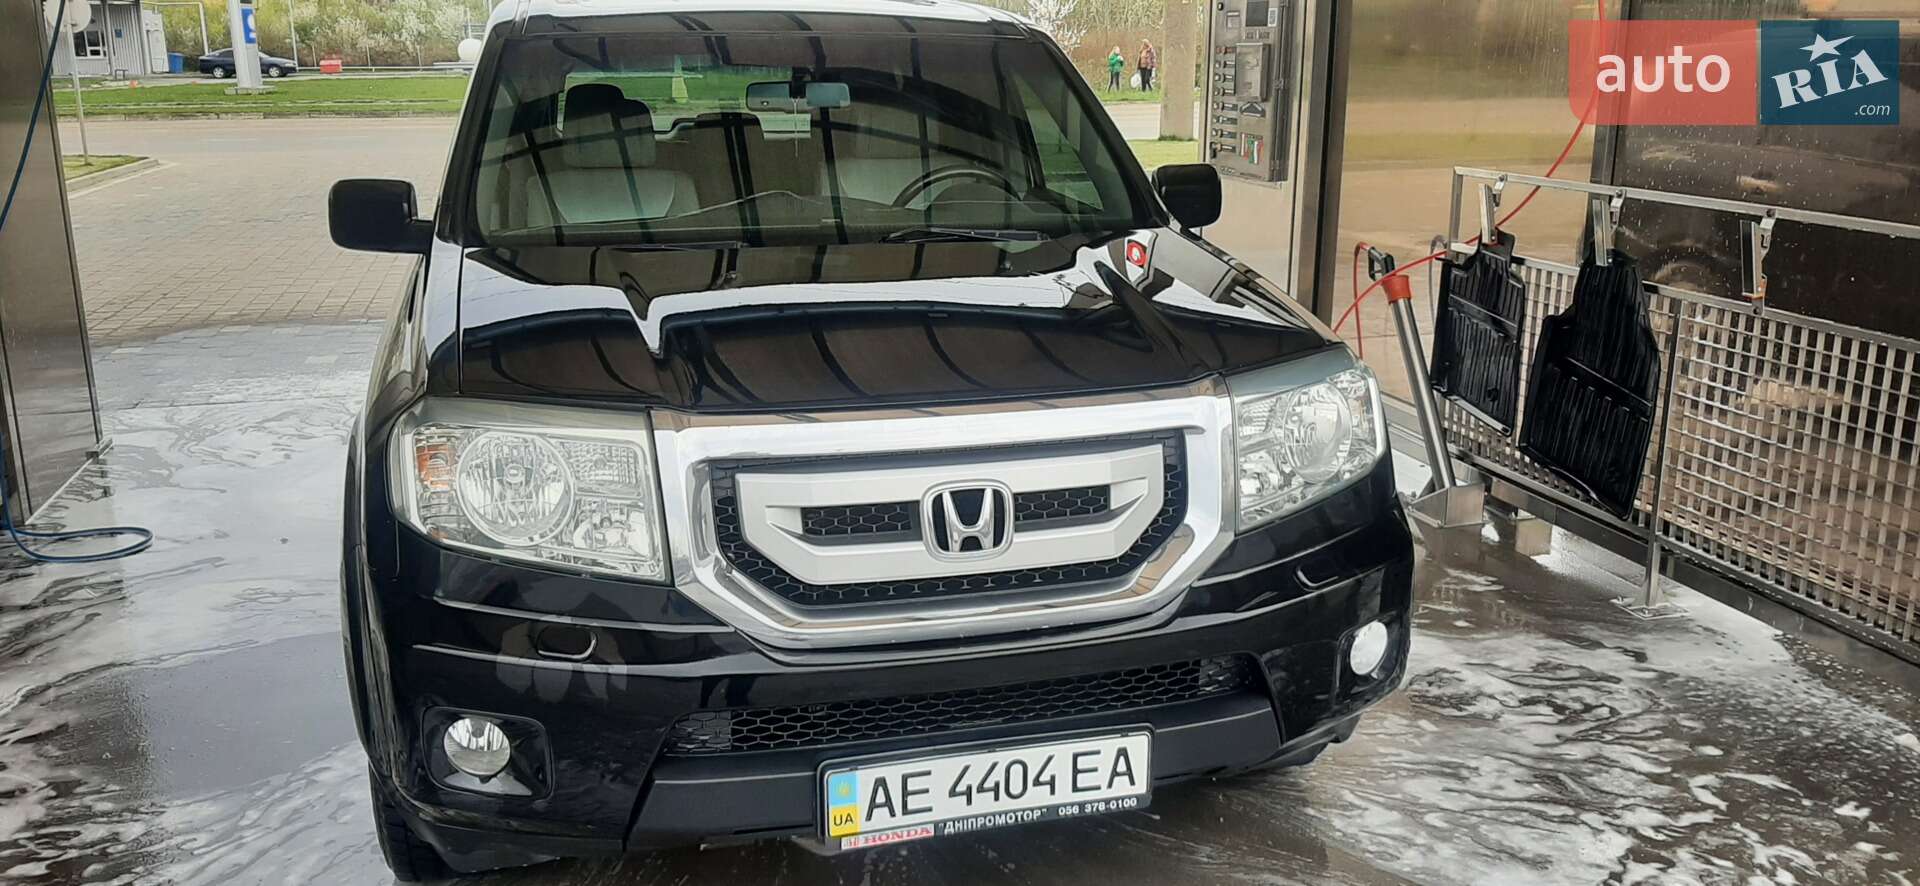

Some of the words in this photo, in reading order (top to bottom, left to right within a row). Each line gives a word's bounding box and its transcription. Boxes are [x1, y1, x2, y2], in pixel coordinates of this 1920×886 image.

[865, 769, 933, 822] AE
[948, 754, 1056, 806] 4404
[1071, 746, 1136, 794] EA
[1058, 803, 1079, 816] 056
[1084, 797, 1137, 812] 378-0100
[833, 812, 854, 826] UA
[863, 826, 933, 845] HONDA
